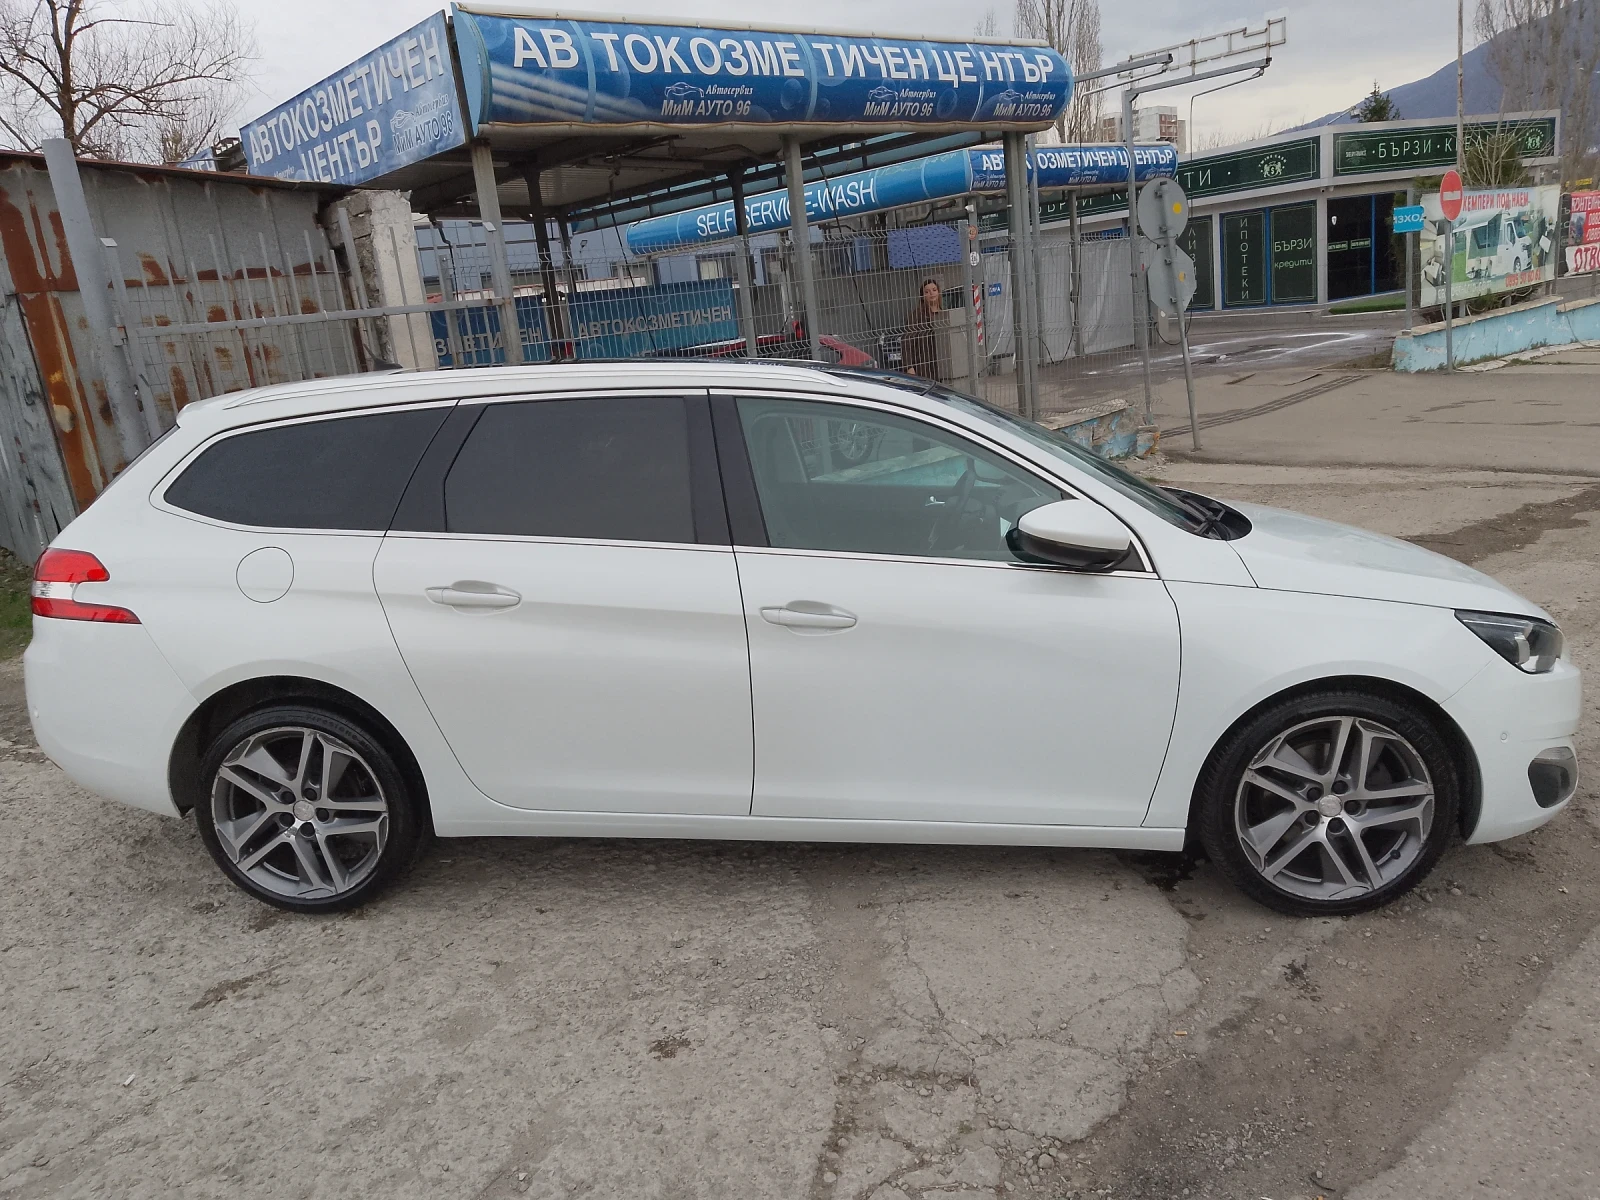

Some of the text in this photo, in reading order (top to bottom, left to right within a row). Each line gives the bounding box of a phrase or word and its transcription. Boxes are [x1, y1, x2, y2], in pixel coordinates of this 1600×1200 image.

[247, 27, 445, 168] АВТОКОЗМЕТИЧЕН
[706, 84, 753, 98] Автосервиз
[899, 88, 937, 101] Автосервиз
[661, 99, 752, 116] МиМ АУТО 96
[864, 101, 933, 117] МиМ АУТО 96
[993, 102, 1053, 116] МиМ АУТО 96
[415, 117, 440, 147] АУТО
[441, 110, 454, 137] 96
[301, 119, 383, 183] ЦЕНТЪР
[1378, 138, 1432, 158] БЪРЗИ
[1119, 149, 1173, 169] ЦЕНТЪР
[1497, 193, 1511, 210] ПОД
[1511, 191, 1529, 208] НАЕМ
[696, 208, 734, 237] SELF
[1274, 237, 1313, 252] БЪРЗИ
[1239, 217, 1250, 300] ИПОТЕКИ
[1274, 257, 1313, 270] кредити
[578, 304, 732, 338] АВТОКОЗМЕТИЧЕН
